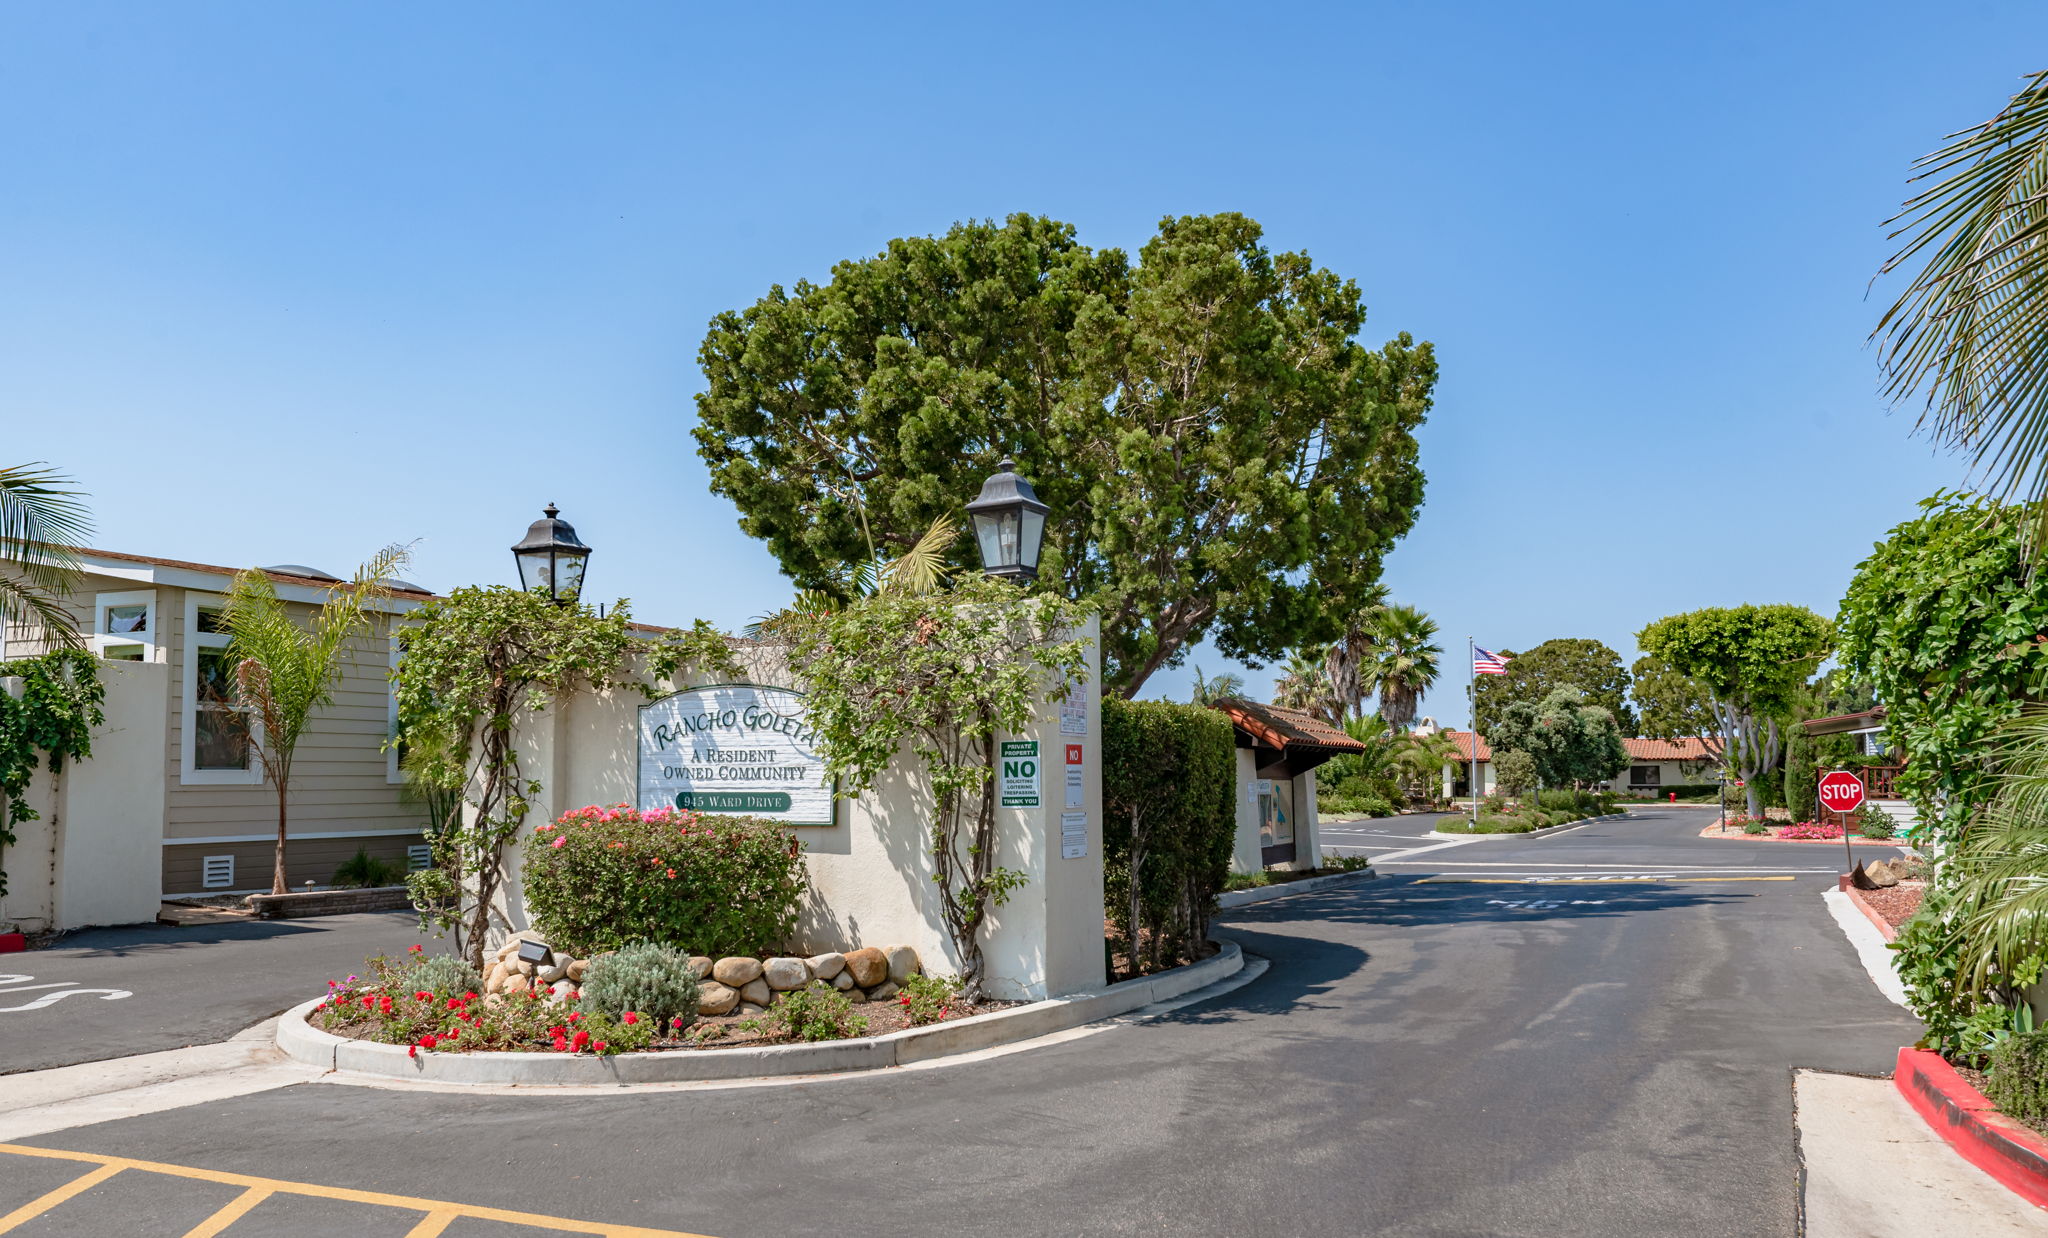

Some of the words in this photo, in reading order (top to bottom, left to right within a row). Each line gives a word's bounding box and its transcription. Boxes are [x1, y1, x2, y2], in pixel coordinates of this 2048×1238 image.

[653, 709, 736, 751] RANCHO
[691, 749, 701, 763] A
[706, 749, 777, 763] RESIDENT
[1070, 750, 1078, 760] NO
[664, 766, 714, 780] OWNED
[719, 765, 807, 781] COMMUNITY
[1004, 760, 1036, 778] NO
[1822, 784, 1860, 800] STOP
[684, 796, 704, 807] 945
[709, 796, 742, 807] WARD
[747, 796, 782, 807] DRIVE
